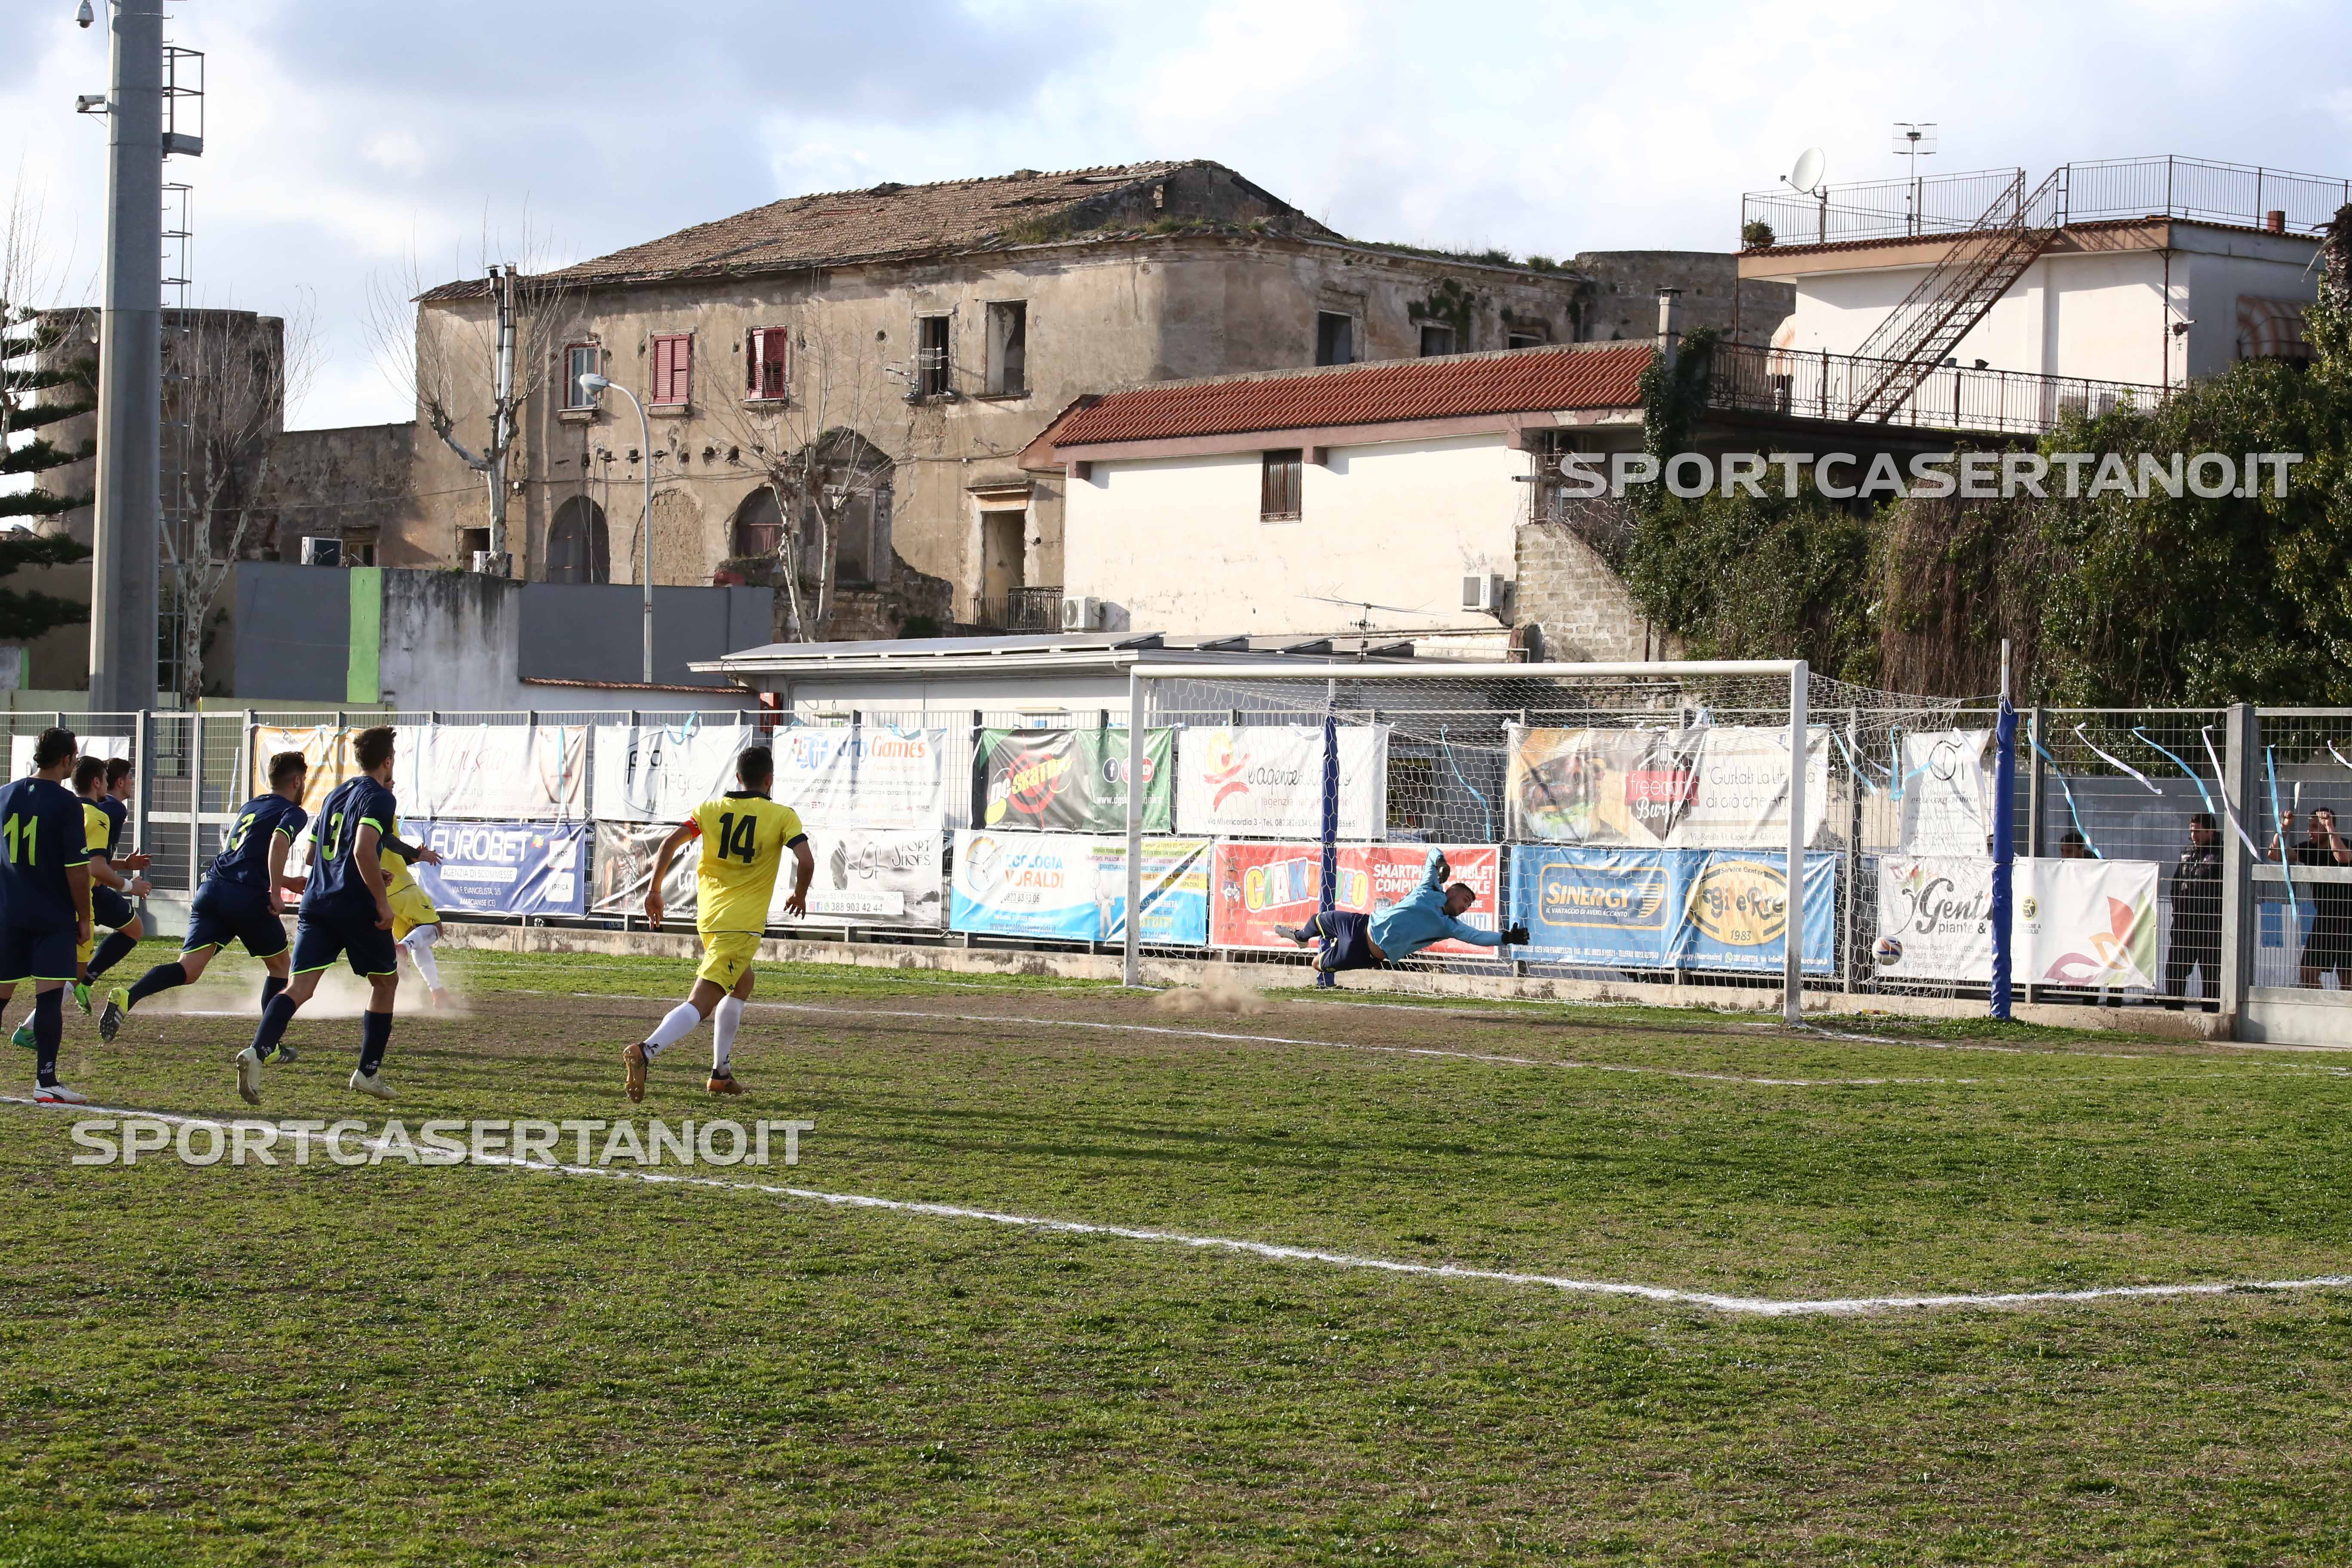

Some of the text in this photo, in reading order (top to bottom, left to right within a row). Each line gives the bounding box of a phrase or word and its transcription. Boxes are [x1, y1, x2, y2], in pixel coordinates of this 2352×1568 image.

[871, 735, 926, 759] Games
[1758, 767, 1769, 784] La
[1773, 765, 1815, 785] Libà
[1263, 798, 1293, 809] agenzia
[1706, 789, 1717, 808] di
[1721, 793, 1739, 808] ciò
[1743, 791, 1767, 808] che
[3, 813, 38, 866] 11
[323, 812, 344, 861] 3
[718, 812, 757, 864] 14
[430, 830, 533, 861] EUROBET
[443, 868, 513, 879] AGENZIA DI SCOMMESSE
[1455, 865, 1495, 879] TABLET
[1721, 866, 1764, 876] Service Center
[464, 887, 493, 896] EVANGELISTA,
[1546, 882, 1634, 908] SINERGY
[459, 898, 487, 906] MARCIANISE
[831, 902, 883, 912] 388 903 42 44
[1730, 930, 1751, 941] 1983
[1938, 922, 1986, 935] piante &
